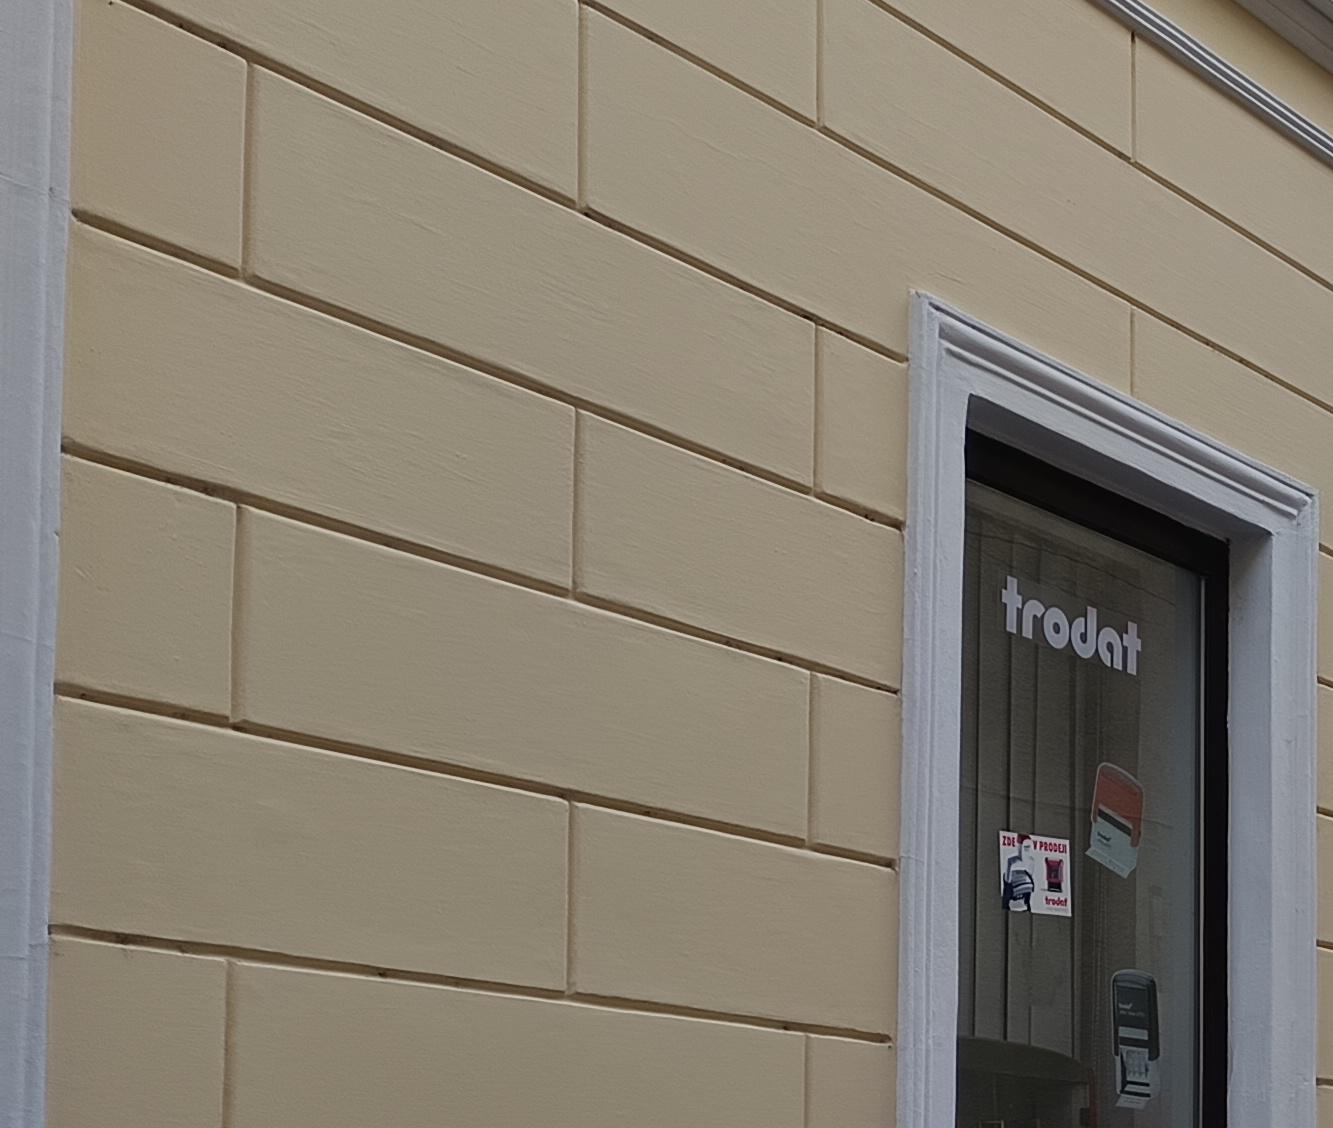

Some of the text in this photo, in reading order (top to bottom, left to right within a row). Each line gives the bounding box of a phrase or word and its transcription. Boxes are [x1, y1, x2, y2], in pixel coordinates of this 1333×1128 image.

[1001, 575, 1142, 676] trodat
[1002, 835, 1015, 847] ZDE
[1039, 841, 1067, 854] PRODEJI
[1045, 896, 1068, 907] trodat
